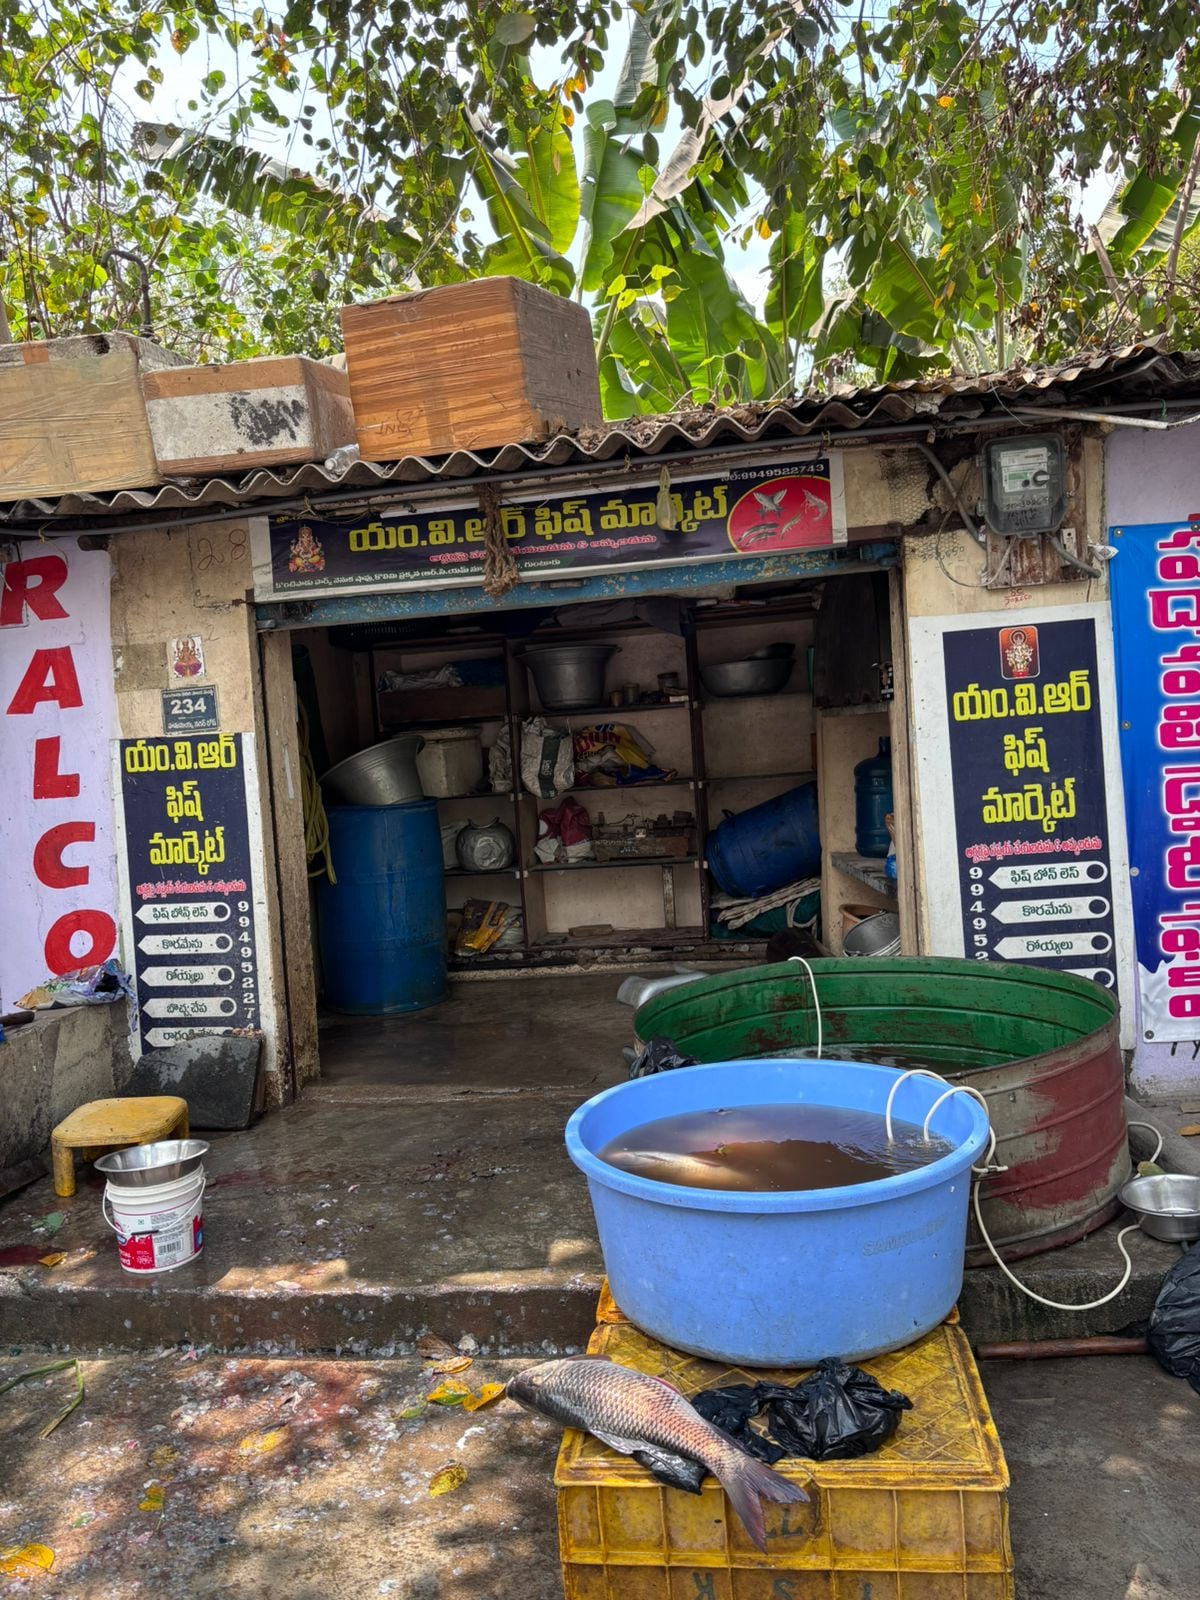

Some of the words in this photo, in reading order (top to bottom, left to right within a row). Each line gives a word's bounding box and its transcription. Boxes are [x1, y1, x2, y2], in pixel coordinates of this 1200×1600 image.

[534, 500, 594, 541] ఫిష్
[170, 697, 207, 715] 234
[953, 670, 1091, 721] యం.వి.ఆర్
[125, 733, 236, 773] యం.వి.ఆర్
[1003, 727, 1050, 776] ఫిష్
[166, 781, 204, 822] ఫిష్
[981, 778, 1076, 833] మార్కెట్
[149, 826, 225, 875] మార్కెట్
[1010, 869, 1031, 885] ఫిష్
[1060, 865, 1079, 879] లెస్
[153, 907, 170, 920] ఫిష్
[1022, 902, 1073, 916] కొరమేను
